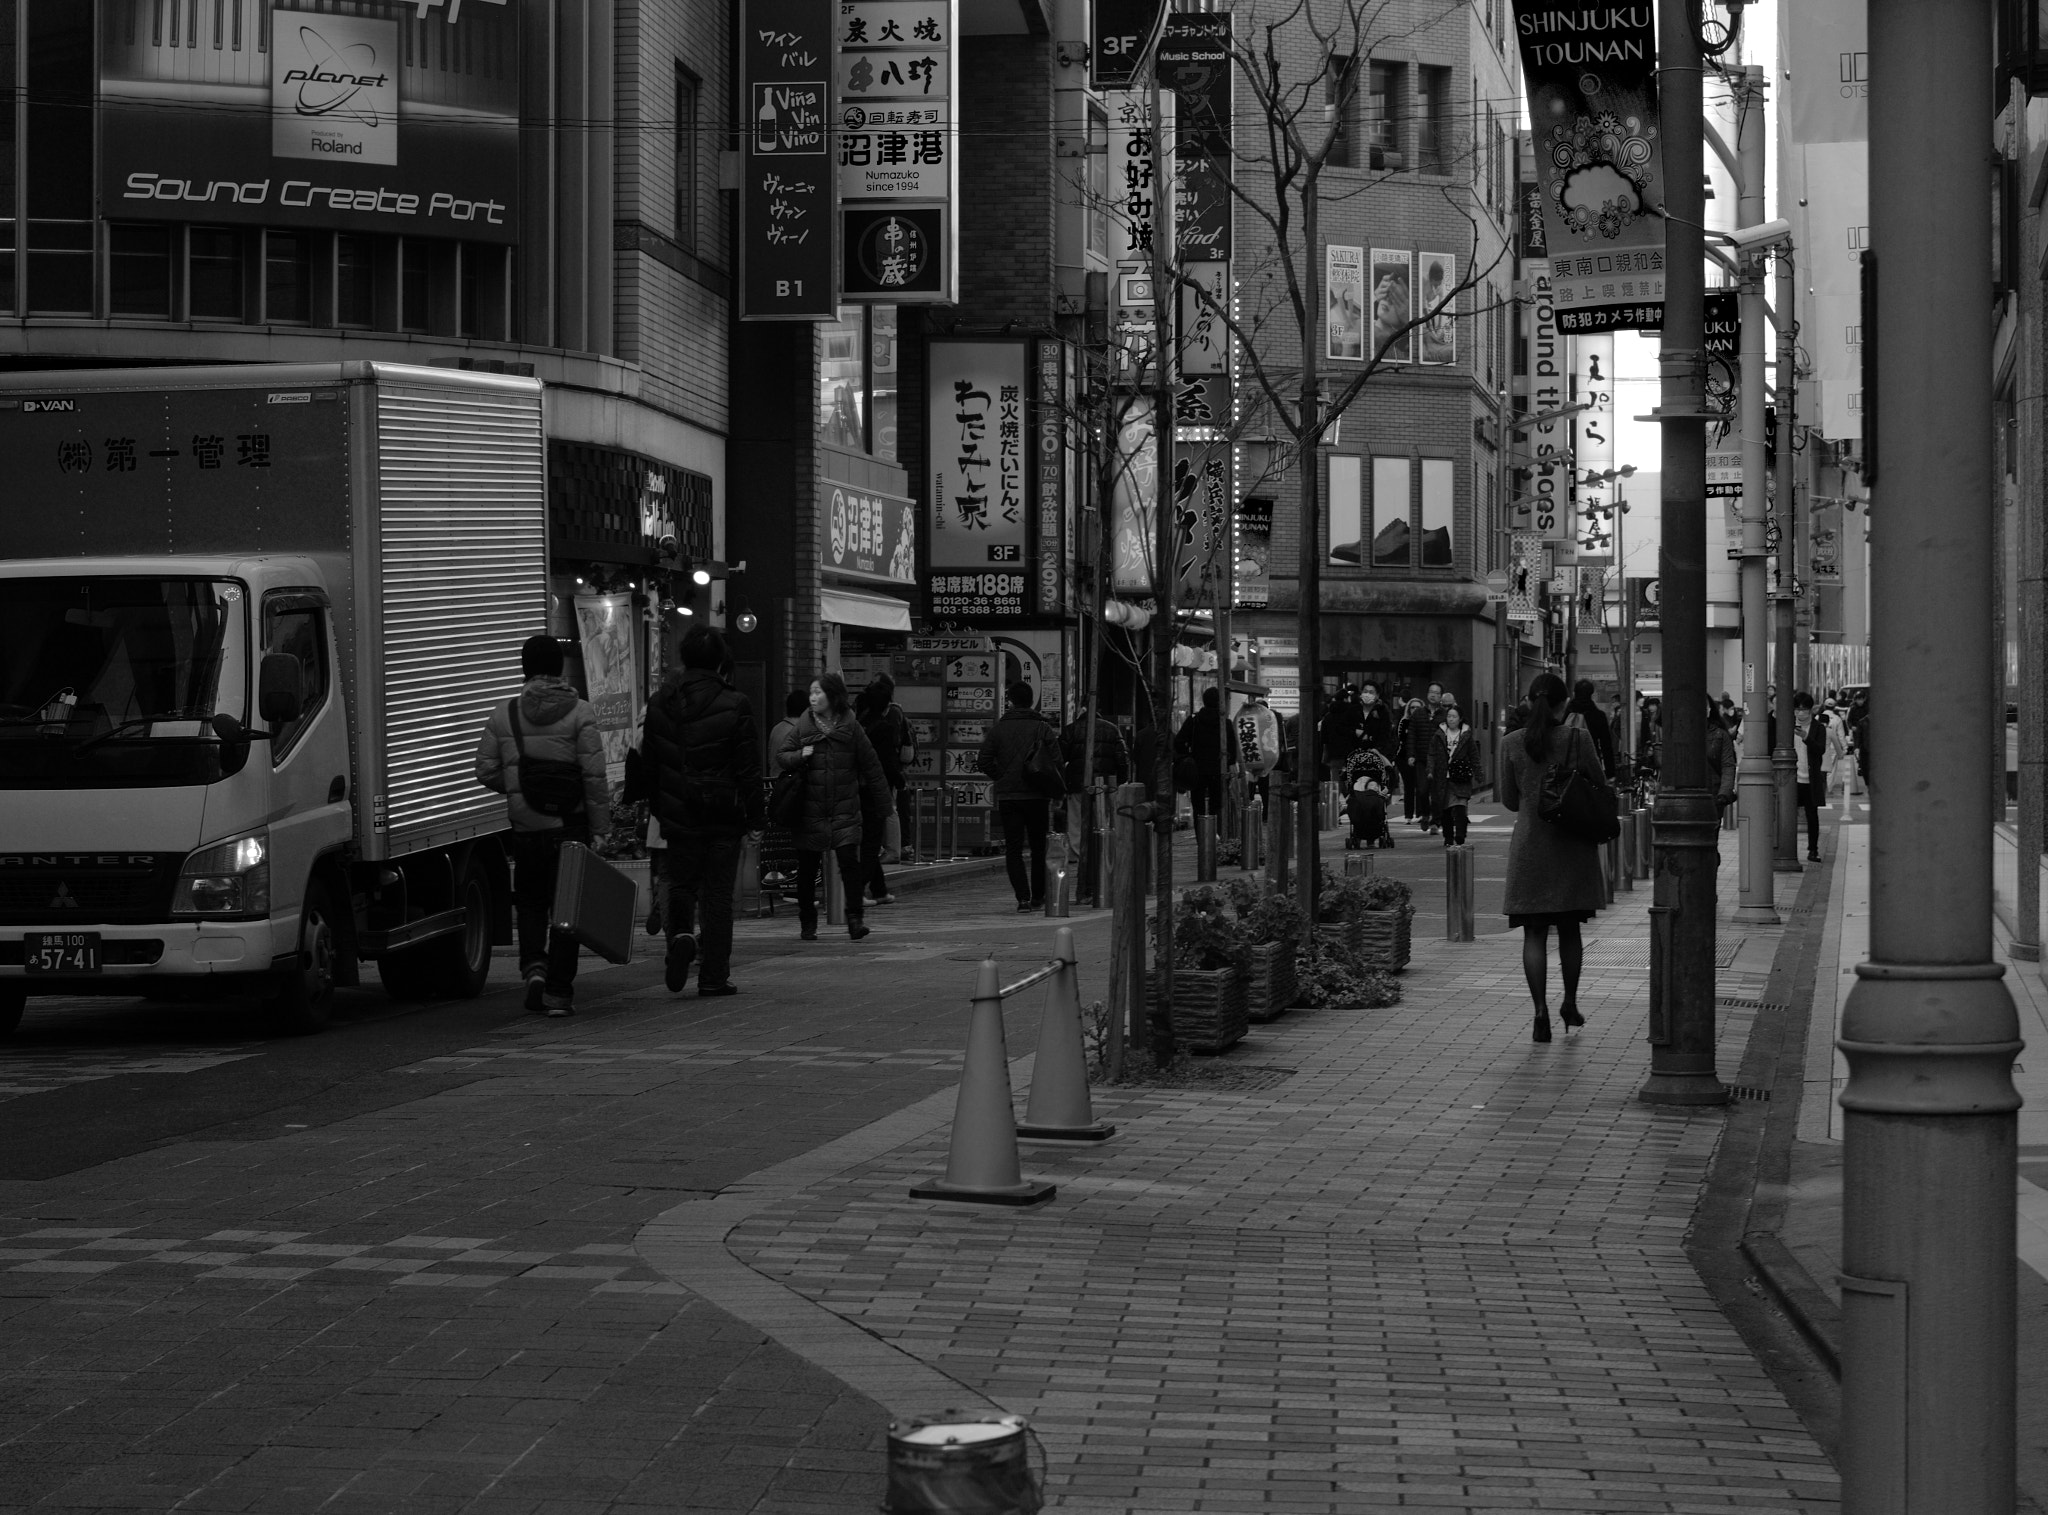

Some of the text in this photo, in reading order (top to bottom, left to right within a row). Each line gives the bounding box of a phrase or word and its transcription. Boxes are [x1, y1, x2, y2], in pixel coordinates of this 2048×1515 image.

[841, 5, 855, 15] 2F
[844, 17, 942, 43] 炭火焼
[1519, 6, 1649, 36] SHINJUKU
[758, 30, 802, 47] ワイン
[1103, 35, 1138, 55] 3F
[781, 51, 818, 68] バル
[1160, 51, 1225, 61] Music School
[1530, 39, 1644, 67] TOUNAN
[283, 64, 388, 88] planet
[791, 108, 820, 130] Vin
[869, 109, 939, 125] 回転寿司
[312, 138, 362, 155] Roland
[780, 125, 820, 150] Vino
[842, 130, 943, 166] 沼津港
[866, 169, 920, 181] Numazuko
[866, 181, 920, 192] since 1994
[123, 172, 506, 224] Sound Create Port
[770, 198, 807, 220] ヴァン
[766, 224, 809, 245] ヴィーノ
[1209, 247, 1224, 259] 3F
[1331, 249, 1360, 264] SAKURA
[1554, 250, 1664, 279] 東南口親和会
[1559, 281, 1664, 303] 路上喫煙禁止
[1561, 306, 1663, 330] 防犯カメラ作動中
[1331, 325, 1344, 337] 3F
[1043, 345, 1058, 356] 30
[954, 380, 992, 531] わたみん家
[1000, 385, 1020, 524] 炭火焼だいにんぐ
[1042, 466, 1058, 477] 70
[935, 472, 947, 530] watamin-chi
[1042, 483, 1058, 537] 飲み放題
[993, 546, 1014, 560] 3F
[931, 573, 1025, 596] 総席数188席
[912, 639, 979, 650] 池田プラザビル
[66, 935, 85, 946] 100
[29, 948, 95, 970] あ 57-41
